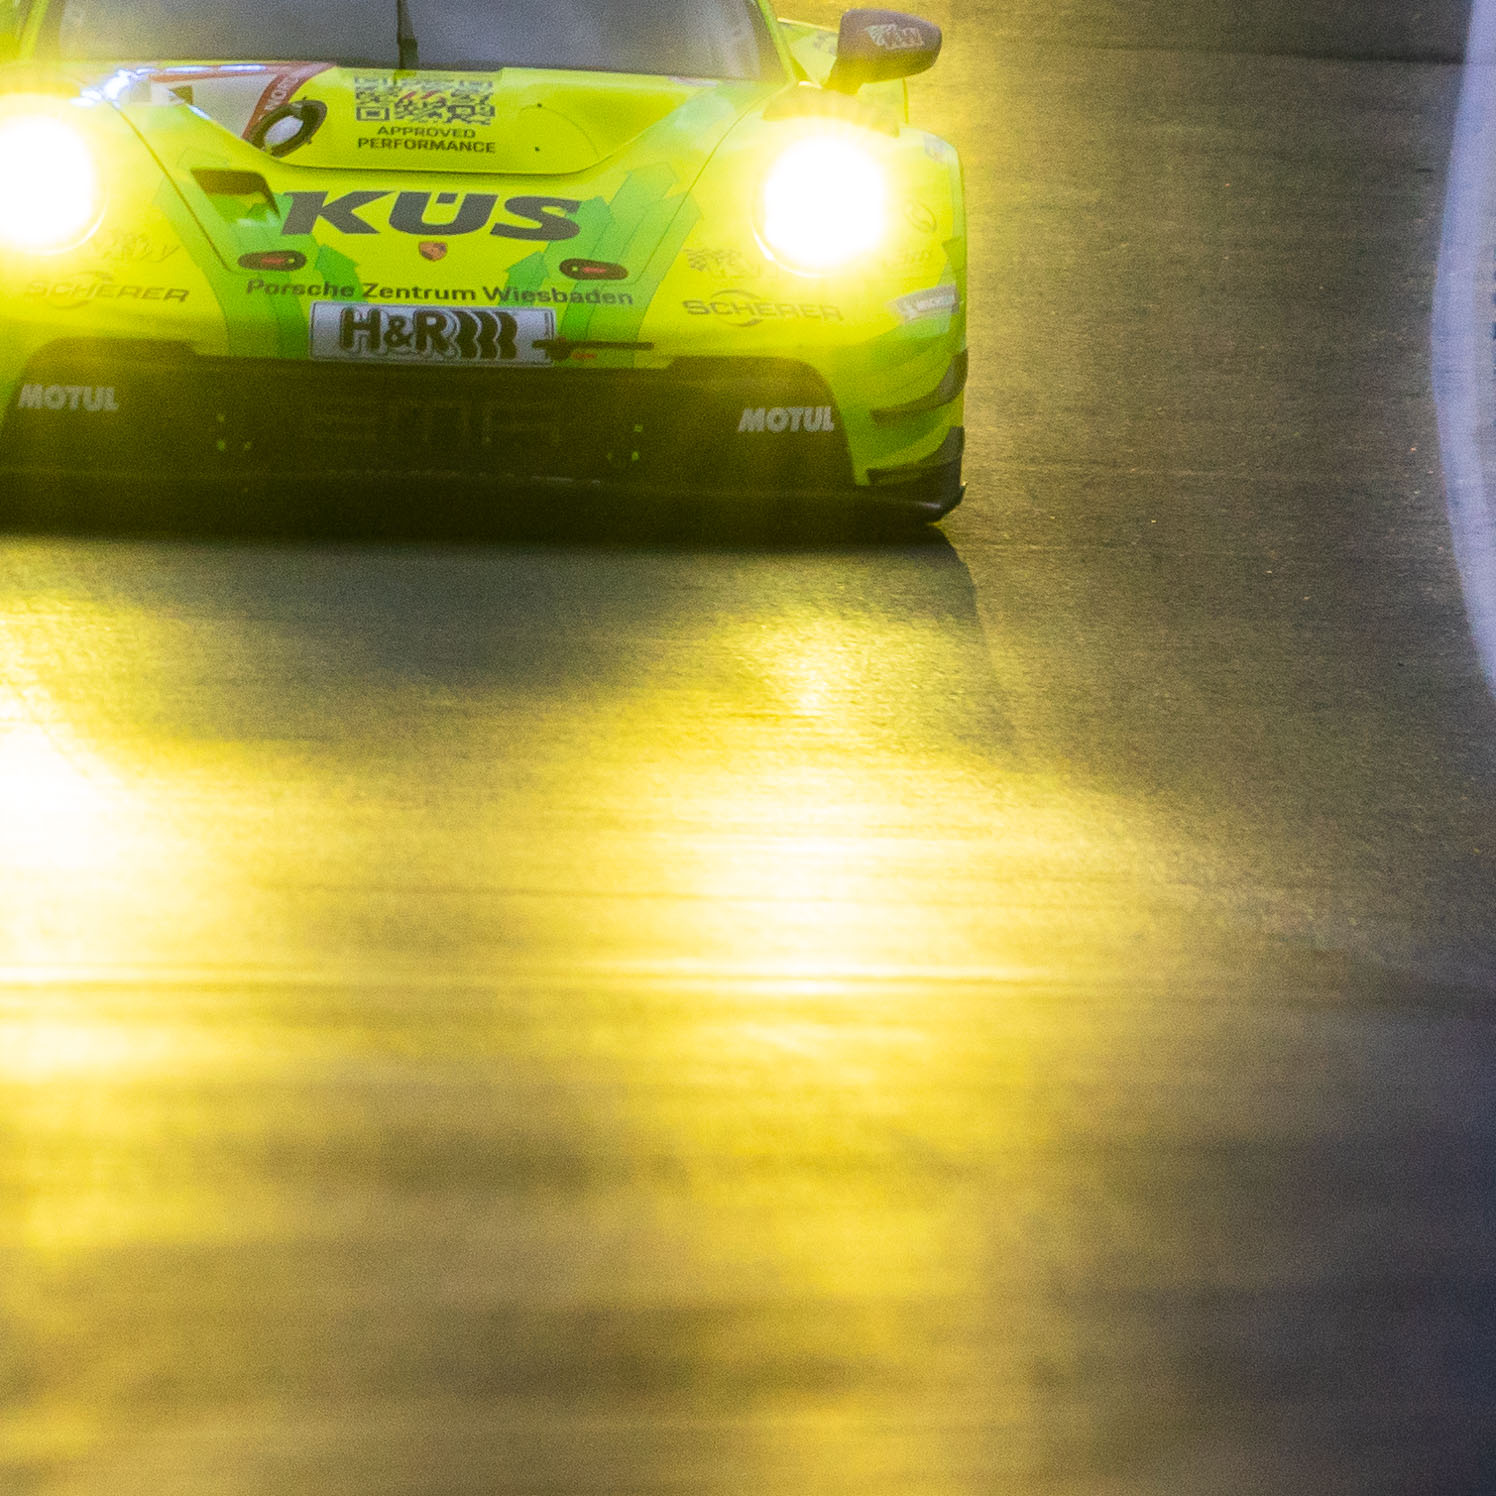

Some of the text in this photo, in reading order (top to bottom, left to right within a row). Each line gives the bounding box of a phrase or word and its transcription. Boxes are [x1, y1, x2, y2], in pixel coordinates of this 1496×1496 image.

[357, 138, 496, 154] PERFORMANCE
[377, 125, 476, 140] APPROVED
[281, 190, 581, 242] KÜS
[246, 278, 633, 306] Porsche Zentrum Wiesbaden
[18, 384, 118, 412] MOTUL
[738, 405, 835, 433] MOTUL
